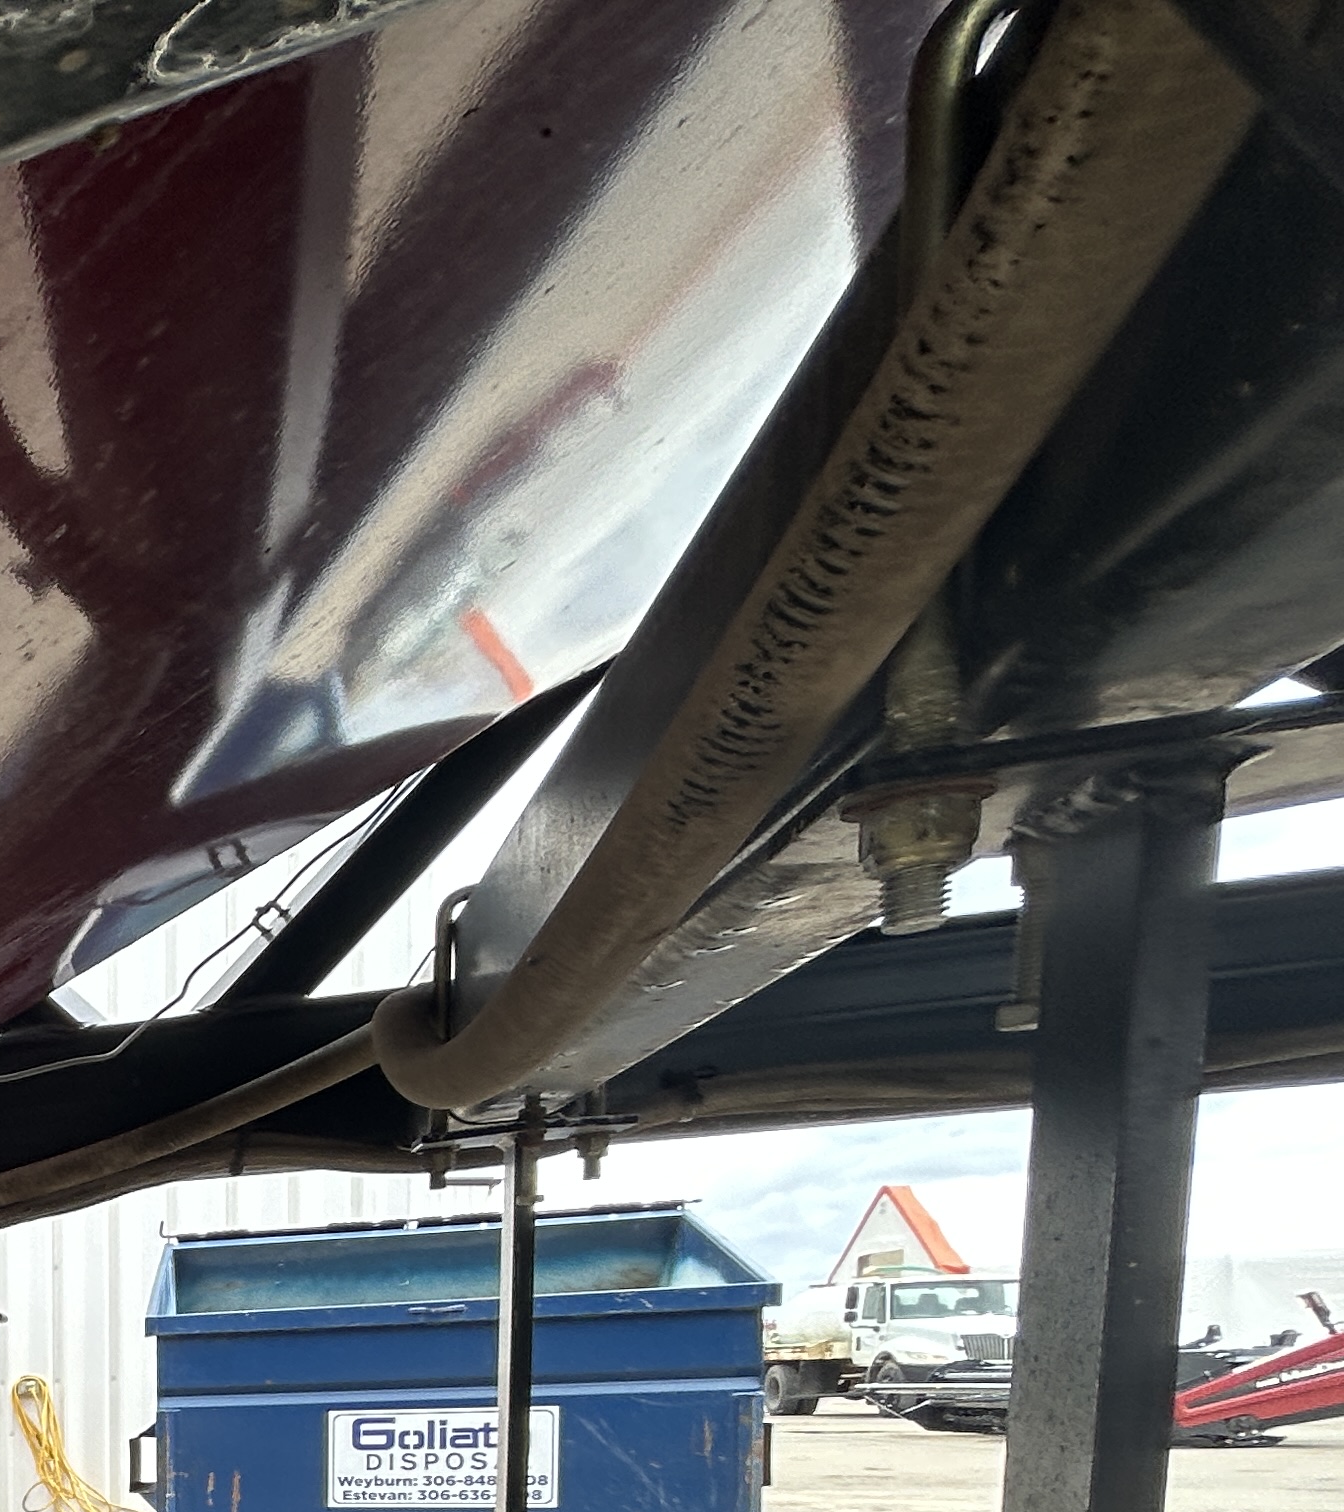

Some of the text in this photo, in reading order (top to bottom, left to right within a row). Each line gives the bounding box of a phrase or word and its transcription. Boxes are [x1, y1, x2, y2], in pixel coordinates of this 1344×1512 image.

[352, 1417, 498, 1450] Goliat
[366, 1452, 532, 1471] DISPOS
[337, 1474, 418, 1489] Weyburn:
[342, 1489, 412, 1501] Estevan:
